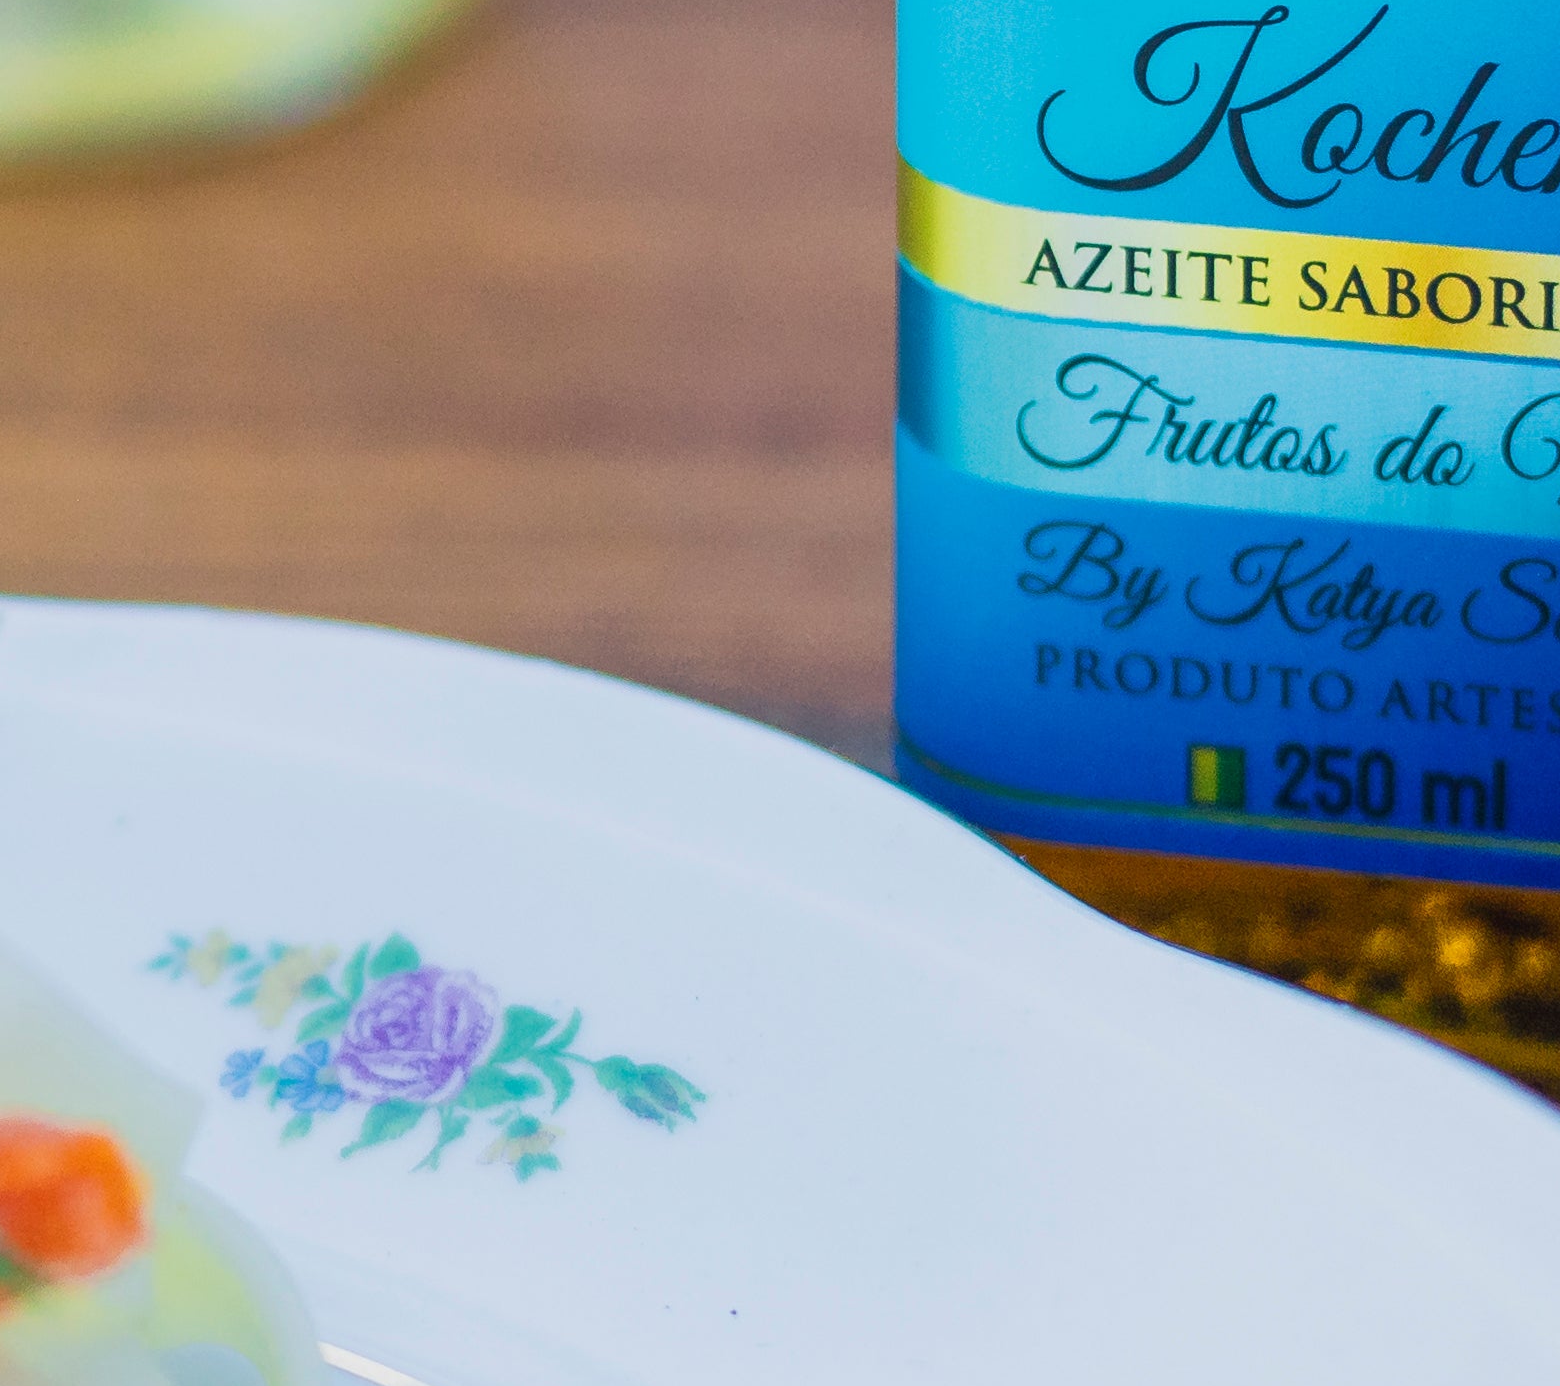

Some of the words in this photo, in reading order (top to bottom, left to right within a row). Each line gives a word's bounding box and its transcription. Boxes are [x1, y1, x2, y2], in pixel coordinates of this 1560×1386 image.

[1023, 238, 1271, 307] AZEITE
[1016, 353, 1346, 477] Frutos
[1374, 404, 1474, 487] do
[1017, 521, 1168, 631] By
[1188, 538, 1443, 647] Katya
[1034, 643, 1355, 714] PRODUTO
[1274, 743, 1396, 817] 250
[1423, 758, 1508, 830] ml
